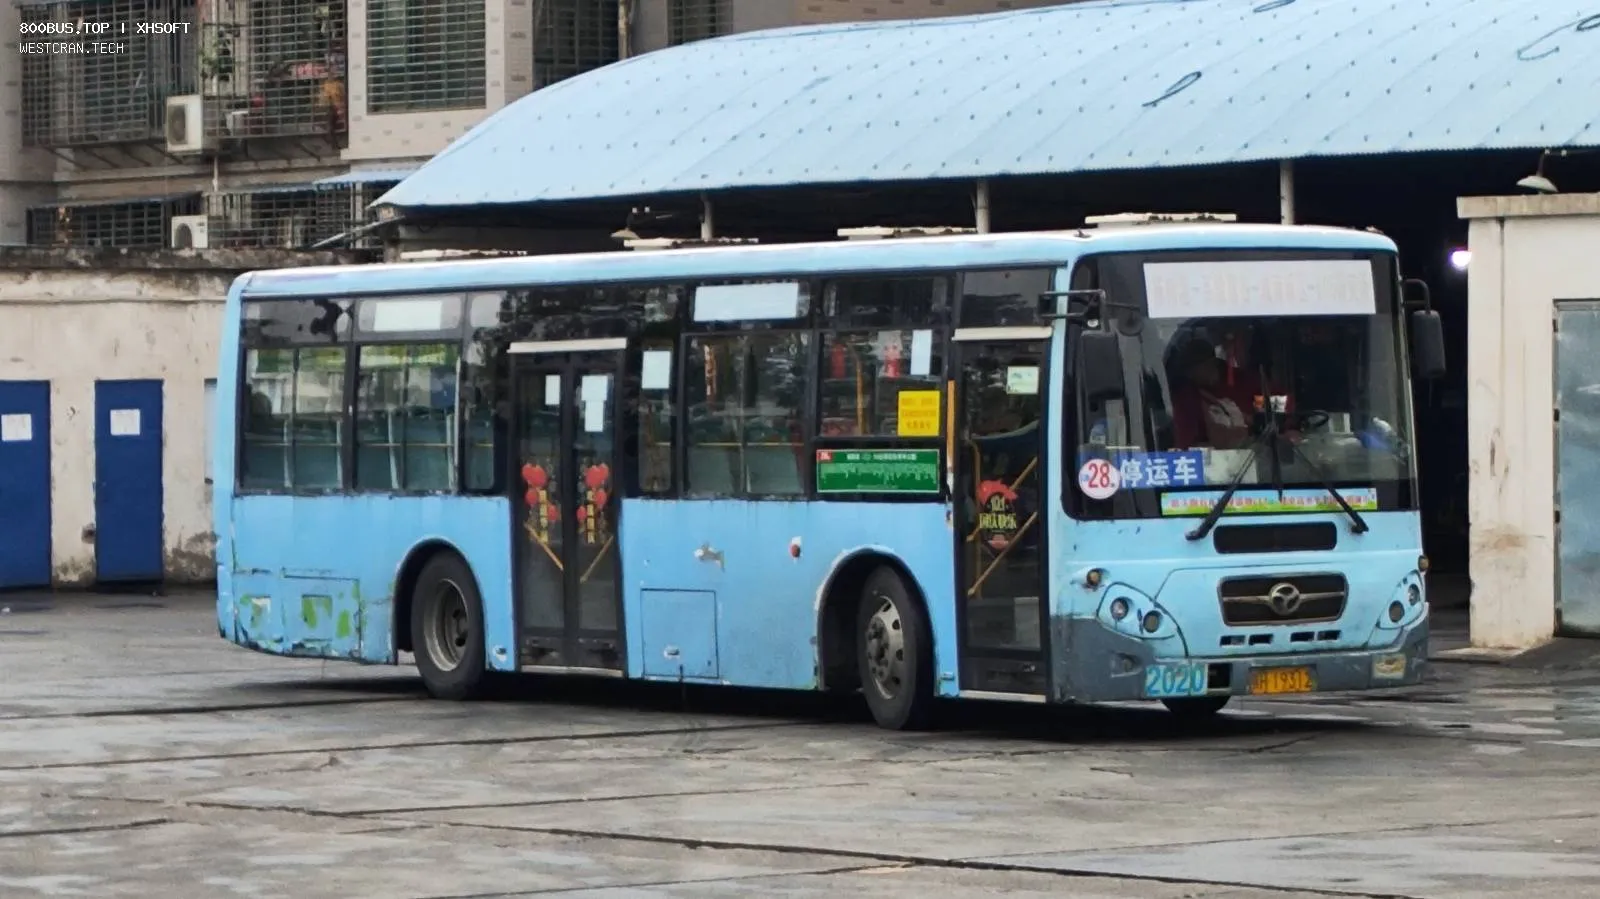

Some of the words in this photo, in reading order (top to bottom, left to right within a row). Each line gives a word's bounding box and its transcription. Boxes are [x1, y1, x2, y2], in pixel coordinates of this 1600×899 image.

[1120, 455, 1198, 488] 停运车
[1146, 664, 1206, 696] 2020
